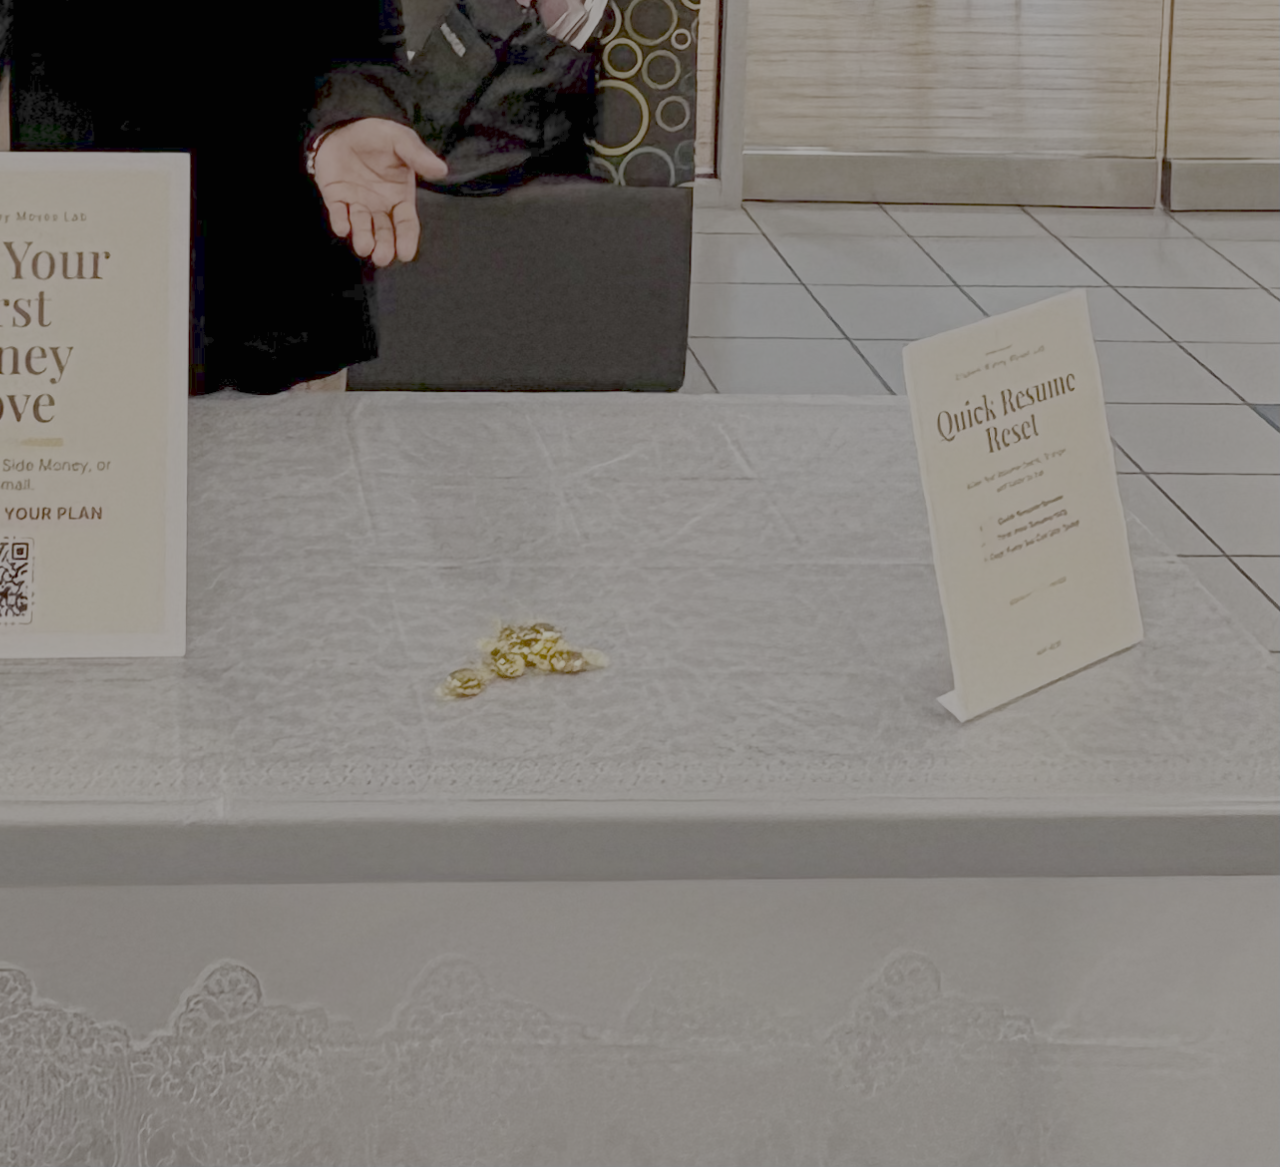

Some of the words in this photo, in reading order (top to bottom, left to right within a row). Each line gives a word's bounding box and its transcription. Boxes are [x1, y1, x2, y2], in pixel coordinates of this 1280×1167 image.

[3, 241, 111, 280] Your
[937, 394, 997, 442] Quick
[1000, 373, 1076, 416] Resume
[985, 414, 1039, 453] Reset
[97, 461, 111, 471] or
[4, 507, 52, 521] YOUR
[57, 506, 102, 520] PLAN
